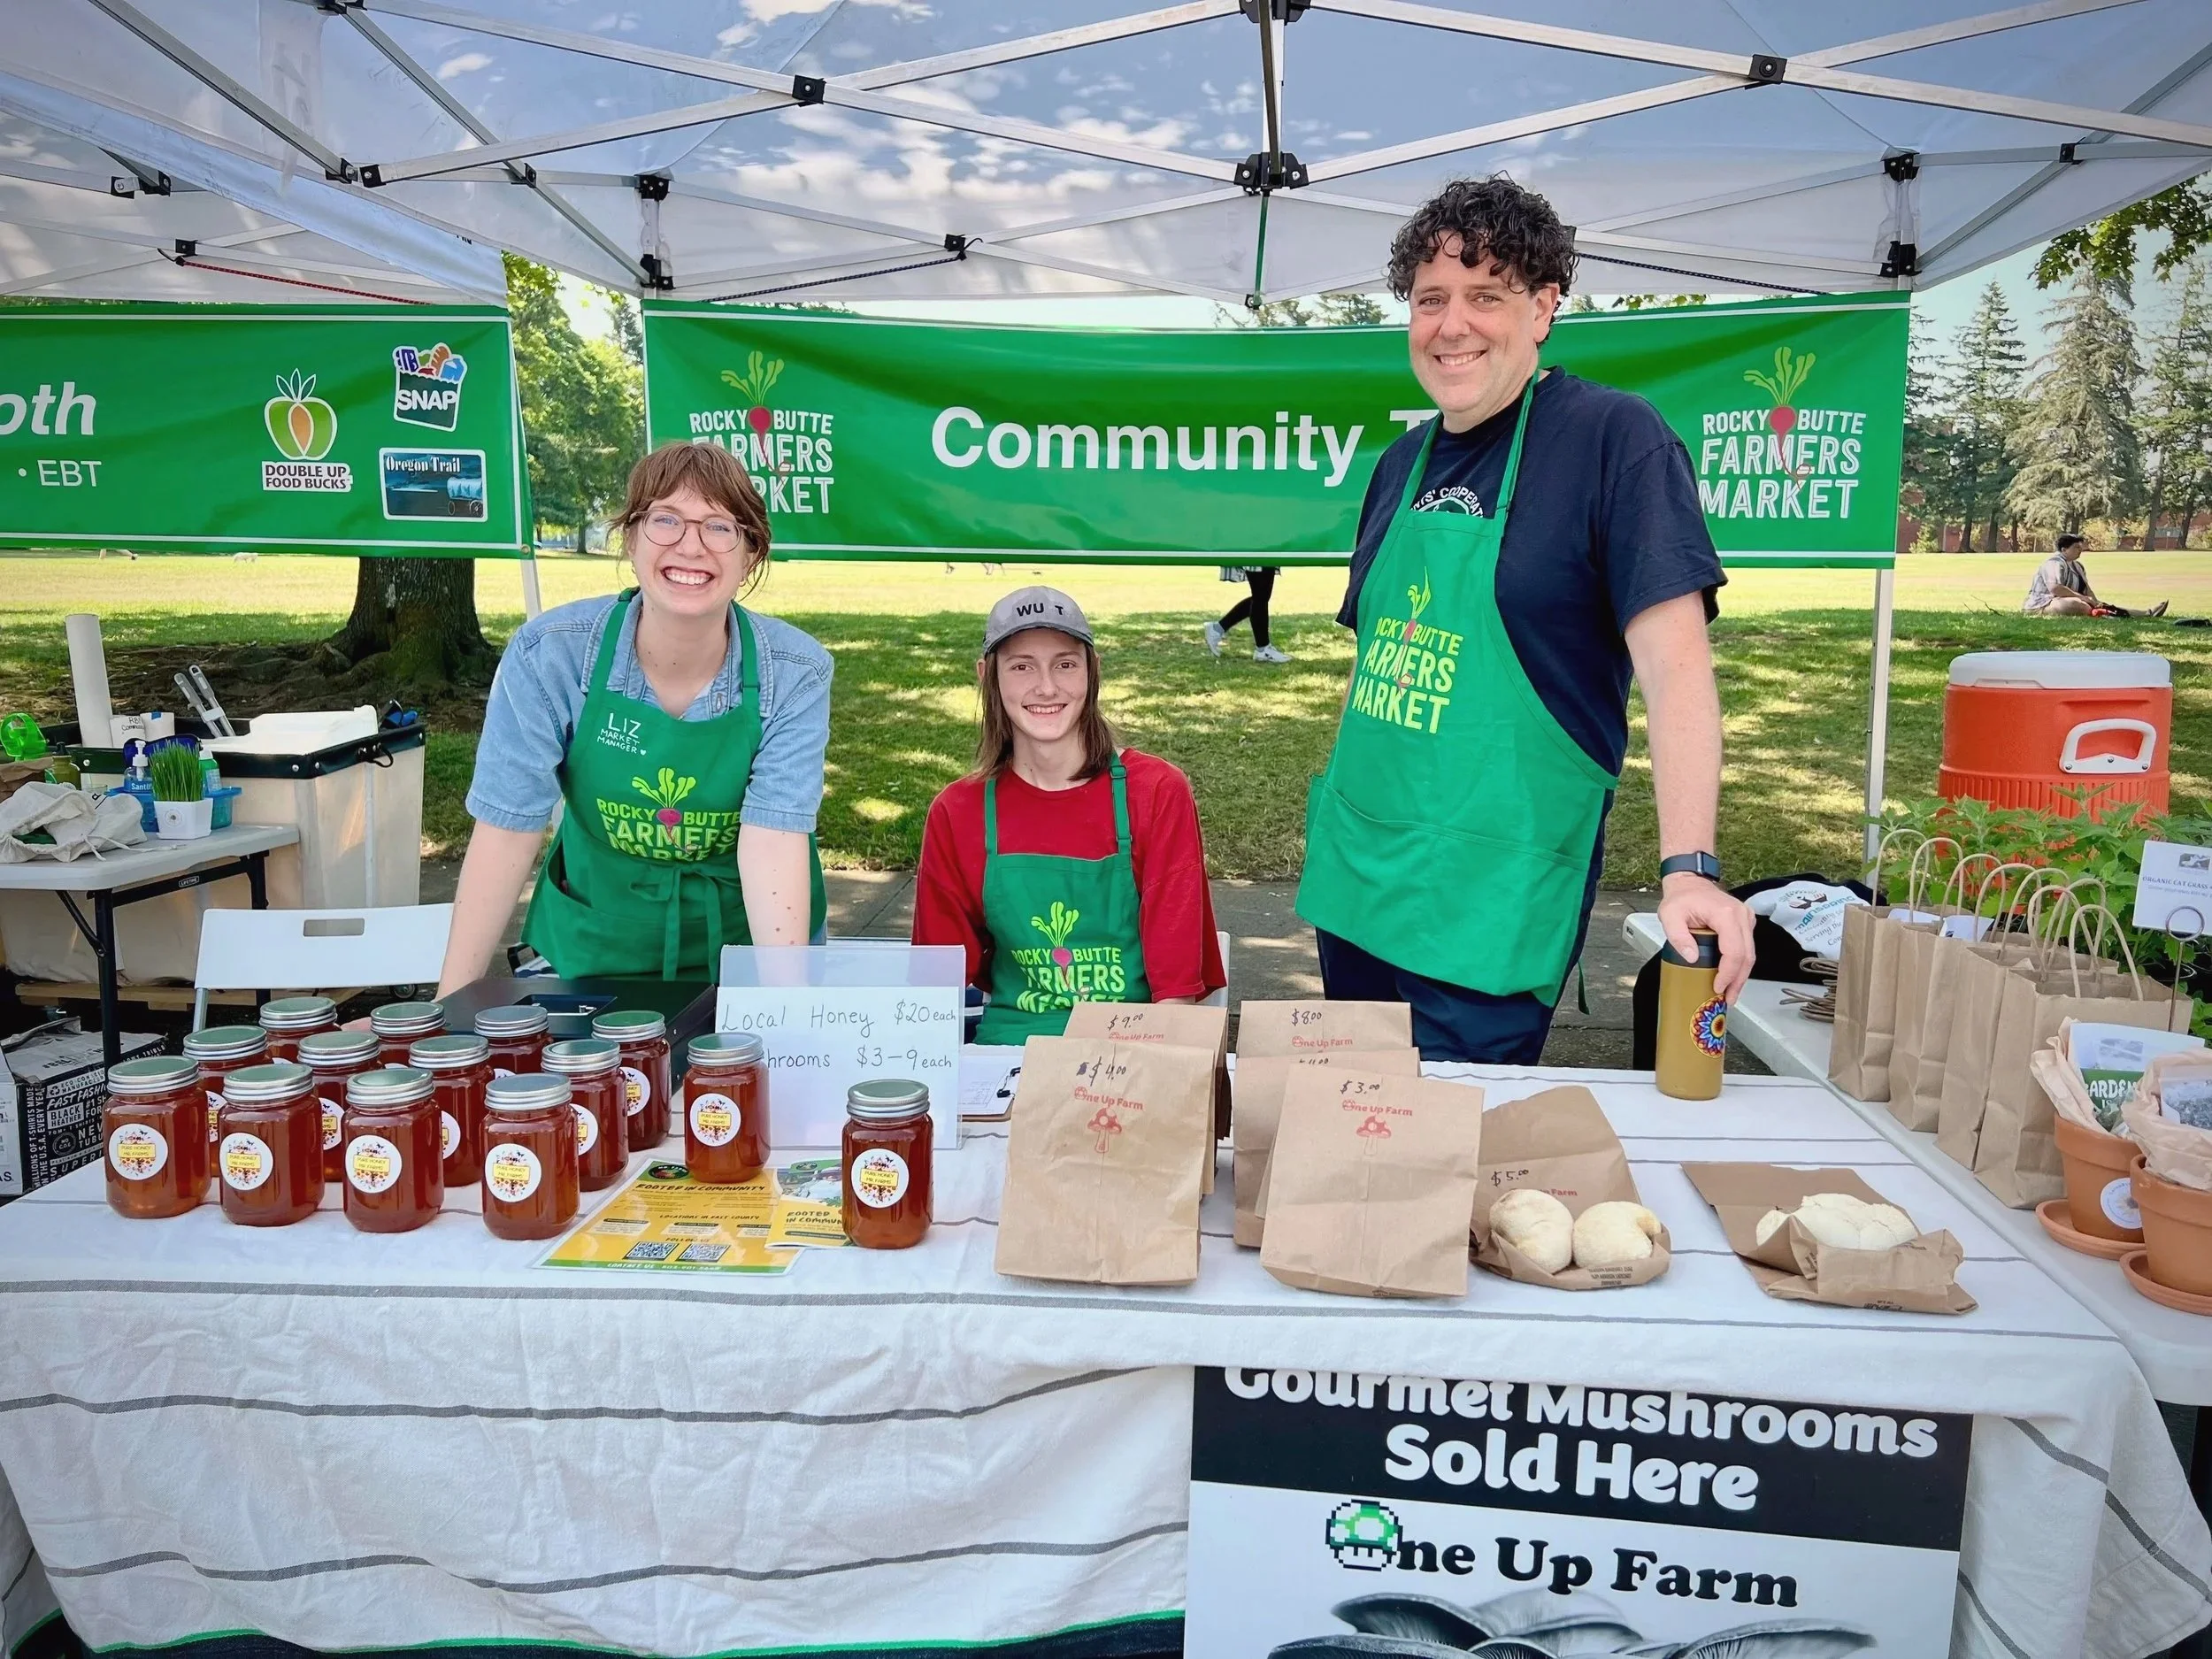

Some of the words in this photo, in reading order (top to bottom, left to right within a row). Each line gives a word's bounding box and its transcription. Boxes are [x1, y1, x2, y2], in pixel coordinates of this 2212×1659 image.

[397, 389, 457, 411] SNAP
[689, 410, 748, 434] ROCKY
[773, 410, 833, 434] BUTTE
[1702, 409, 1770, 435] ROCKY
[1797, 409, 1866, 434] BUTTE
[932, 406, 1364, 488] Community
[1701, 434, 1862, 475] FARMERS
[37, 459, 103, 488] EBT
[265, 465, 323, 478] DOUBLE
[327, 465, 347, 479] UP
[386, 456, 429, 474] Oregon
[432, 456, 461, 473] Trail
[265, 478, 302, 489] FOOD
[304, 478, 347, 490] BUCKS
[1698, 479, 1859, 519] MARKET
[1410, 623, 1463, 656] BUTTE
[608, 712, 641, 739] LIZ
[596, 736, 638, 754] MANAGER
[600, 728, 640, 746] MARKET
[596, 798, 656, 821] ROCKY
[683, 811, 741, 826] BUTTE
[1072, 947, 1122, 964] BUTTE
[721, 1005, 786, 1032] Local
[810, 1004, 875, 1038] Honey
[894, 999, 930, 1025] $20
[933, 1009, 956, 1022] each
[1142, 1033, 1164, 1041] Farm
[921, 1055, 952, 1069] each
[26, 1087, 35, 1107] MADE
[46, 1094, 77, 1110] FAST
[1101, 1094, 1116, 1109] Up
[1117, 1097, 1144, 1111] Farm
[36, 1108, 45, 1133] EVERY
[50, 1105, 81, 1121] BLACK
[51, 1113, 81, 1127] HEATHER
[1369, 1105, 1384, 1115] Up
[1386, 1105, 1413, 1117] Farm
[27, 1109, 36, 1141] T-SHIRTS
[29, 1139, 37, 1152] OF
[31, 1154, 40, 1187] MILLIONS
[1551, 1187, 1578, 1197] Farm
[1225, 1367, 1513, 1421] Gourmet
[1526, 1382, 1939, 1458] Mushrooms
[1385, 1423, 1561, 1494] Sold
[1575, 1440, 1760, 1511] Here
[1495, 1537, 1593, 1594] Up
[1610, 1548, 1798, 1608] Farm
